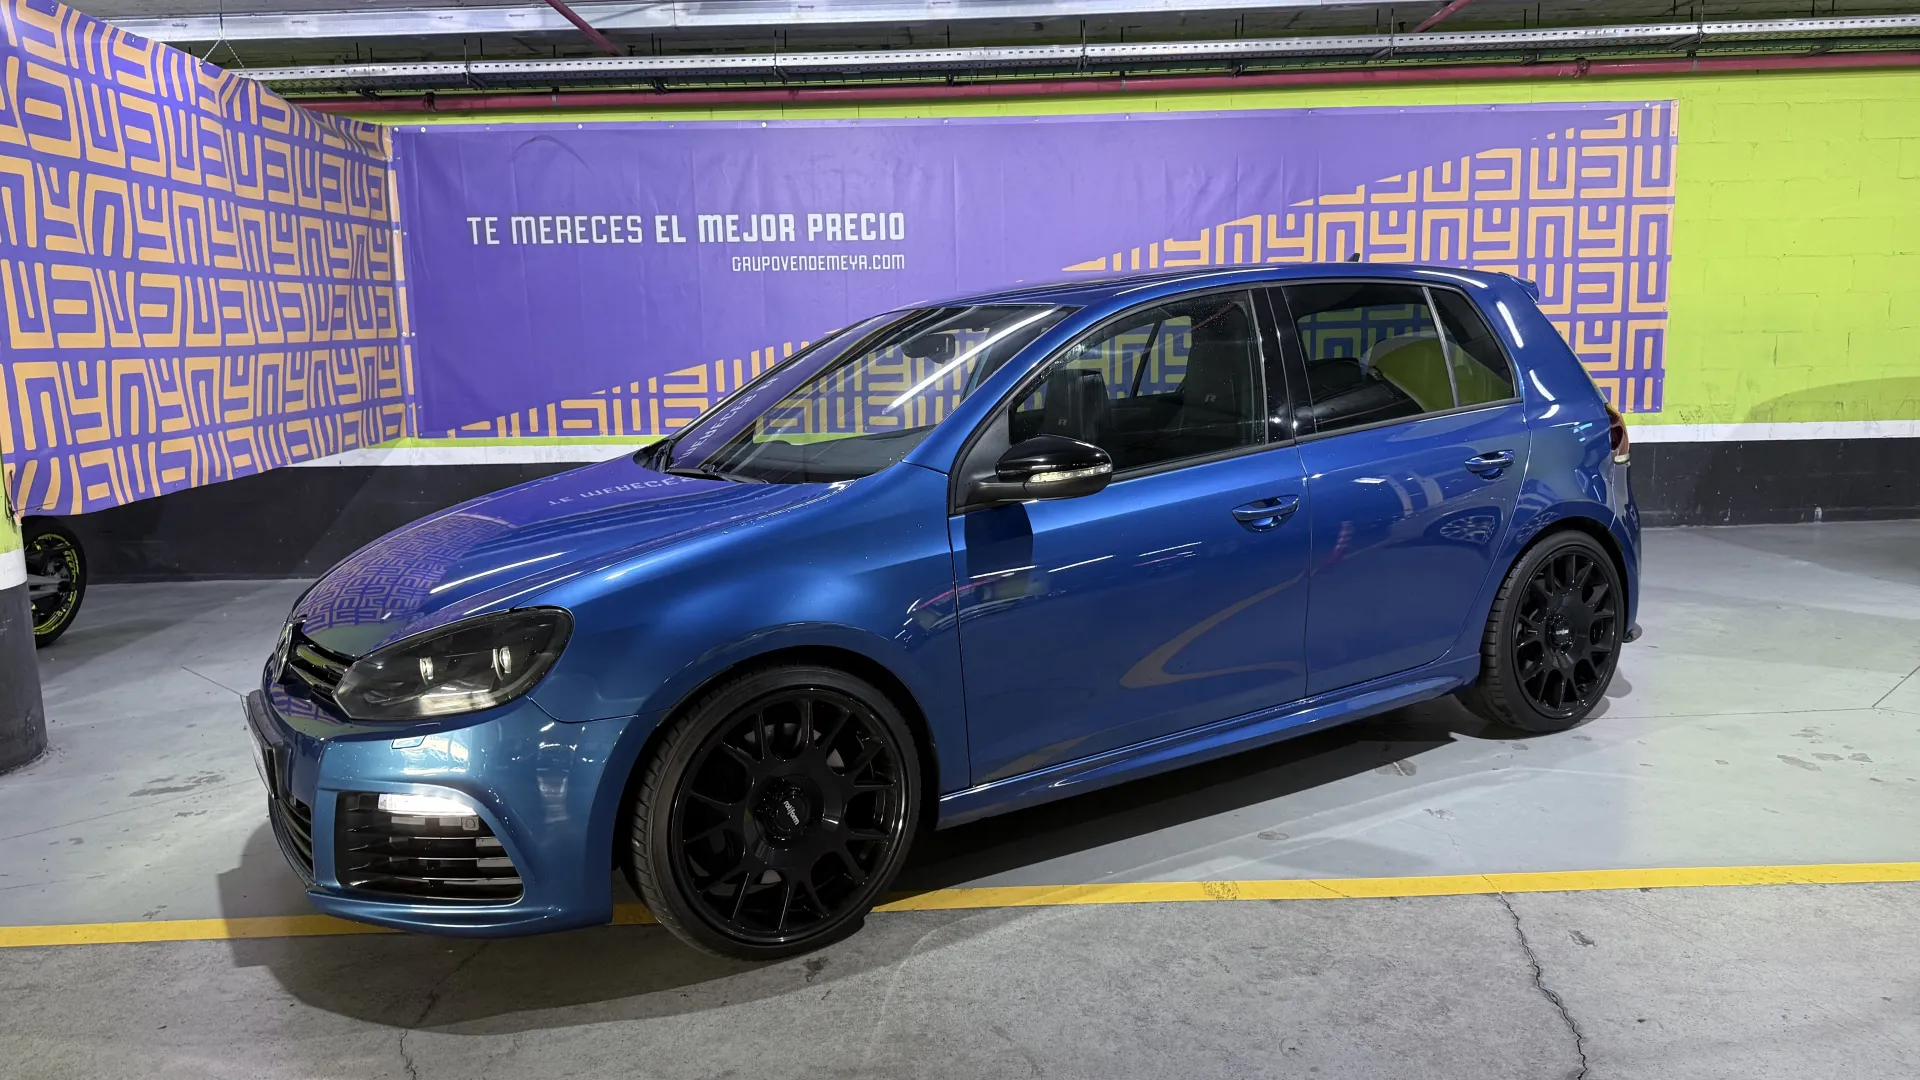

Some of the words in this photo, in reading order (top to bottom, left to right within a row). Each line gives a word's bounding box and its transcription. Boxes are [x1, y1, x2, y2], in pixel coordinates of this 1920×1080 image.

[467, 216, 499, 245] TE
[511, 215, 643, 244] MERECES
[655, 214, 687, 243] EL
[699, 213, 795, 243] MEJOR
[808, 212, 905, 241] PRECIO
[732, 254, 905, 272] GRUPOVENDEMEYA.COM
[1203, 394, 1217, 403] R
[783, 801, 799, 825] rotiform
